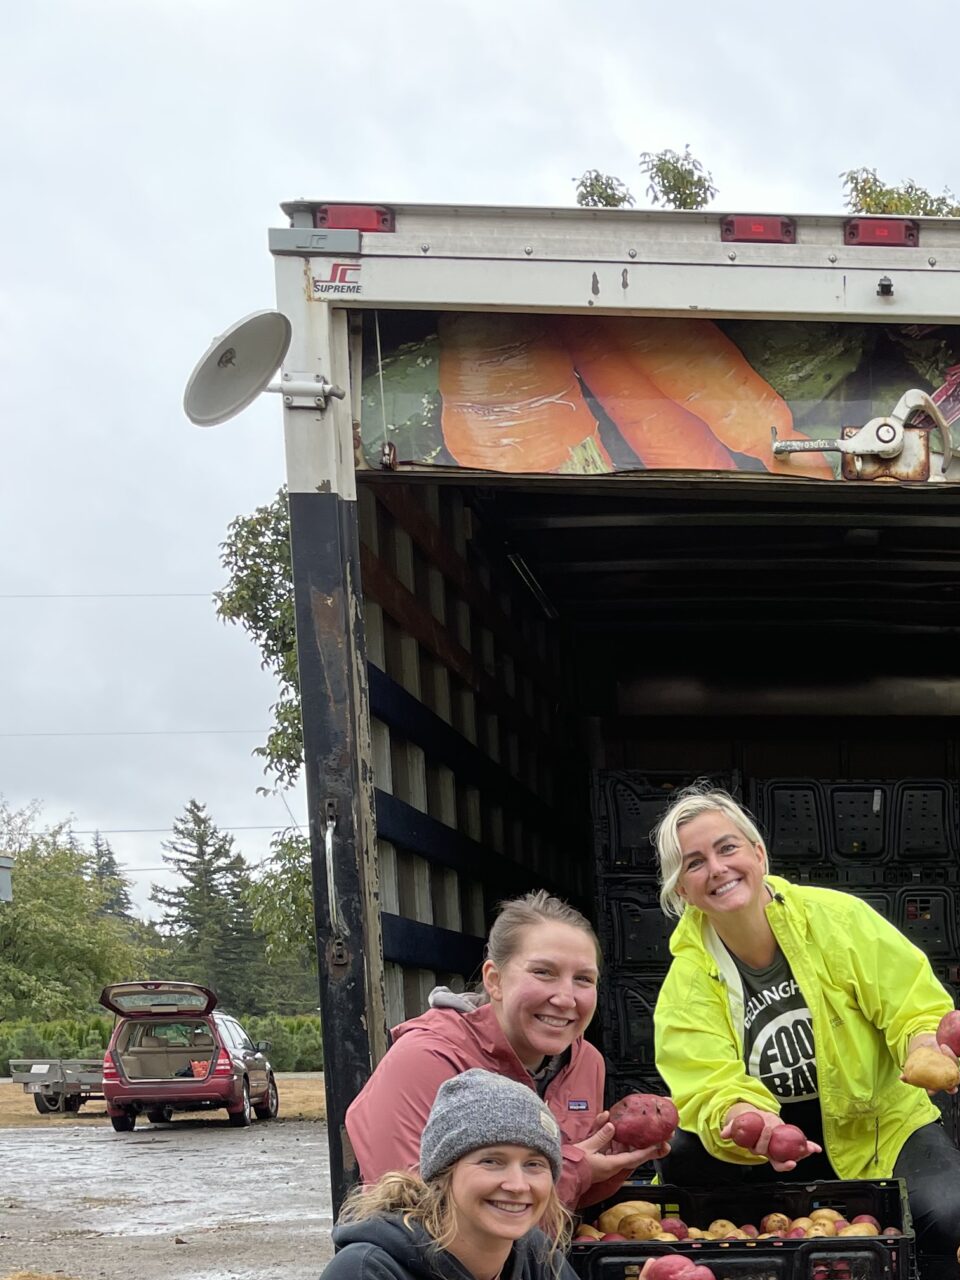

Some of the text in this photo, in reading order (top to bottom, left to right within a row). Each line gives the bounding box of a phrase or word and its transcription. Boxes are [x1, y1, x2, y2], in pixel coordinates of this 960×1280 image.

[314, 284, 362, 293] SUPREME
[759, 1017, 816, 1076] FOO
[760, 1061, 818, 1098] BA
